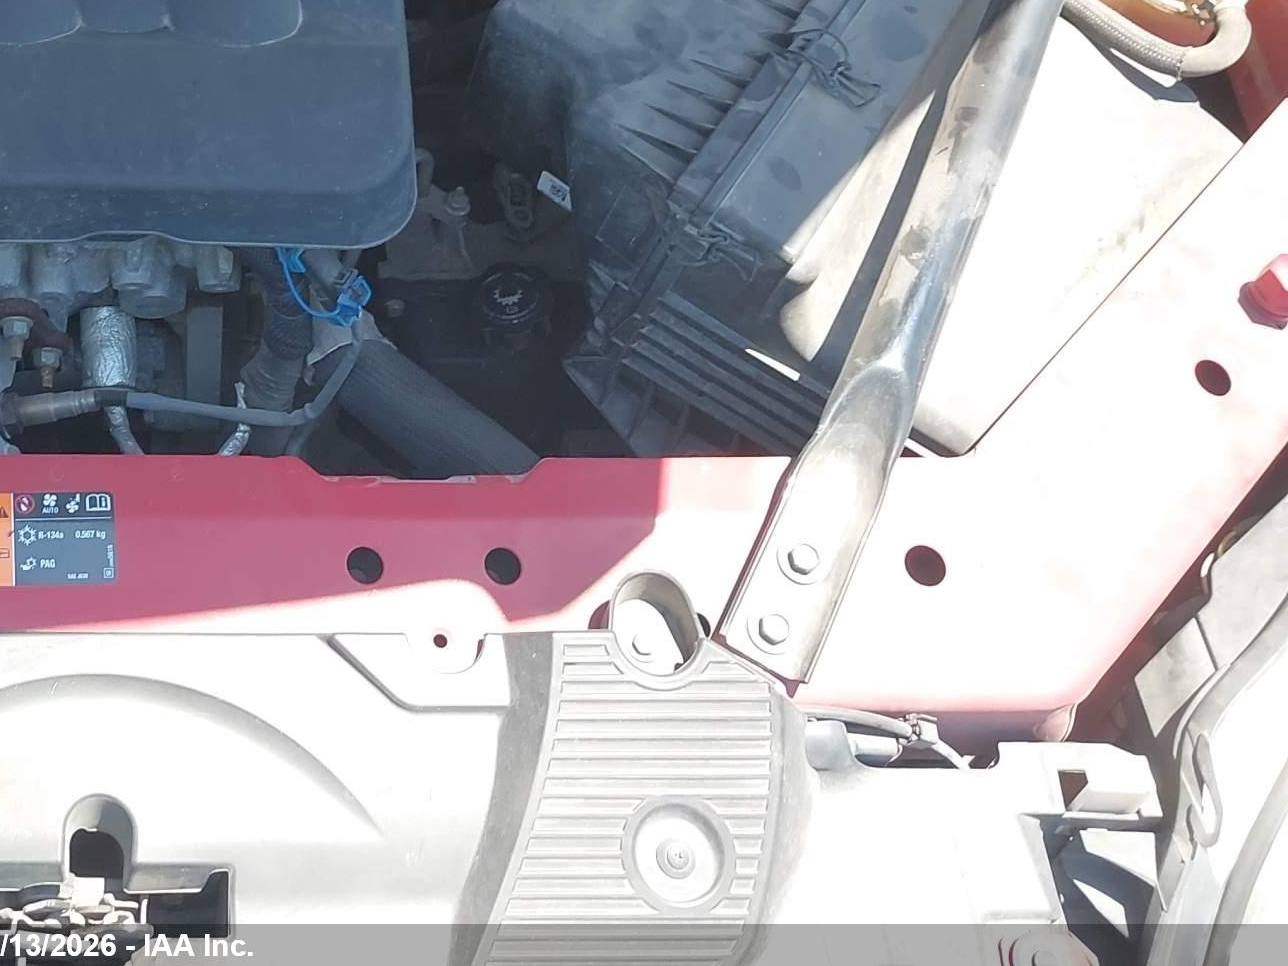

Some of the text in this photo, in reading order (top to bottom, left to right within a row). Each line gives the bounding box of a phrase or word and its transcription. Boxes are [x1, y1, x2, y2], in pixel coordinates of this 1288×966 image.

[42, 506, 59, 514] AUTO
[96, 530, 106, 540] kg
[40, 559, 56, 569] PAG
